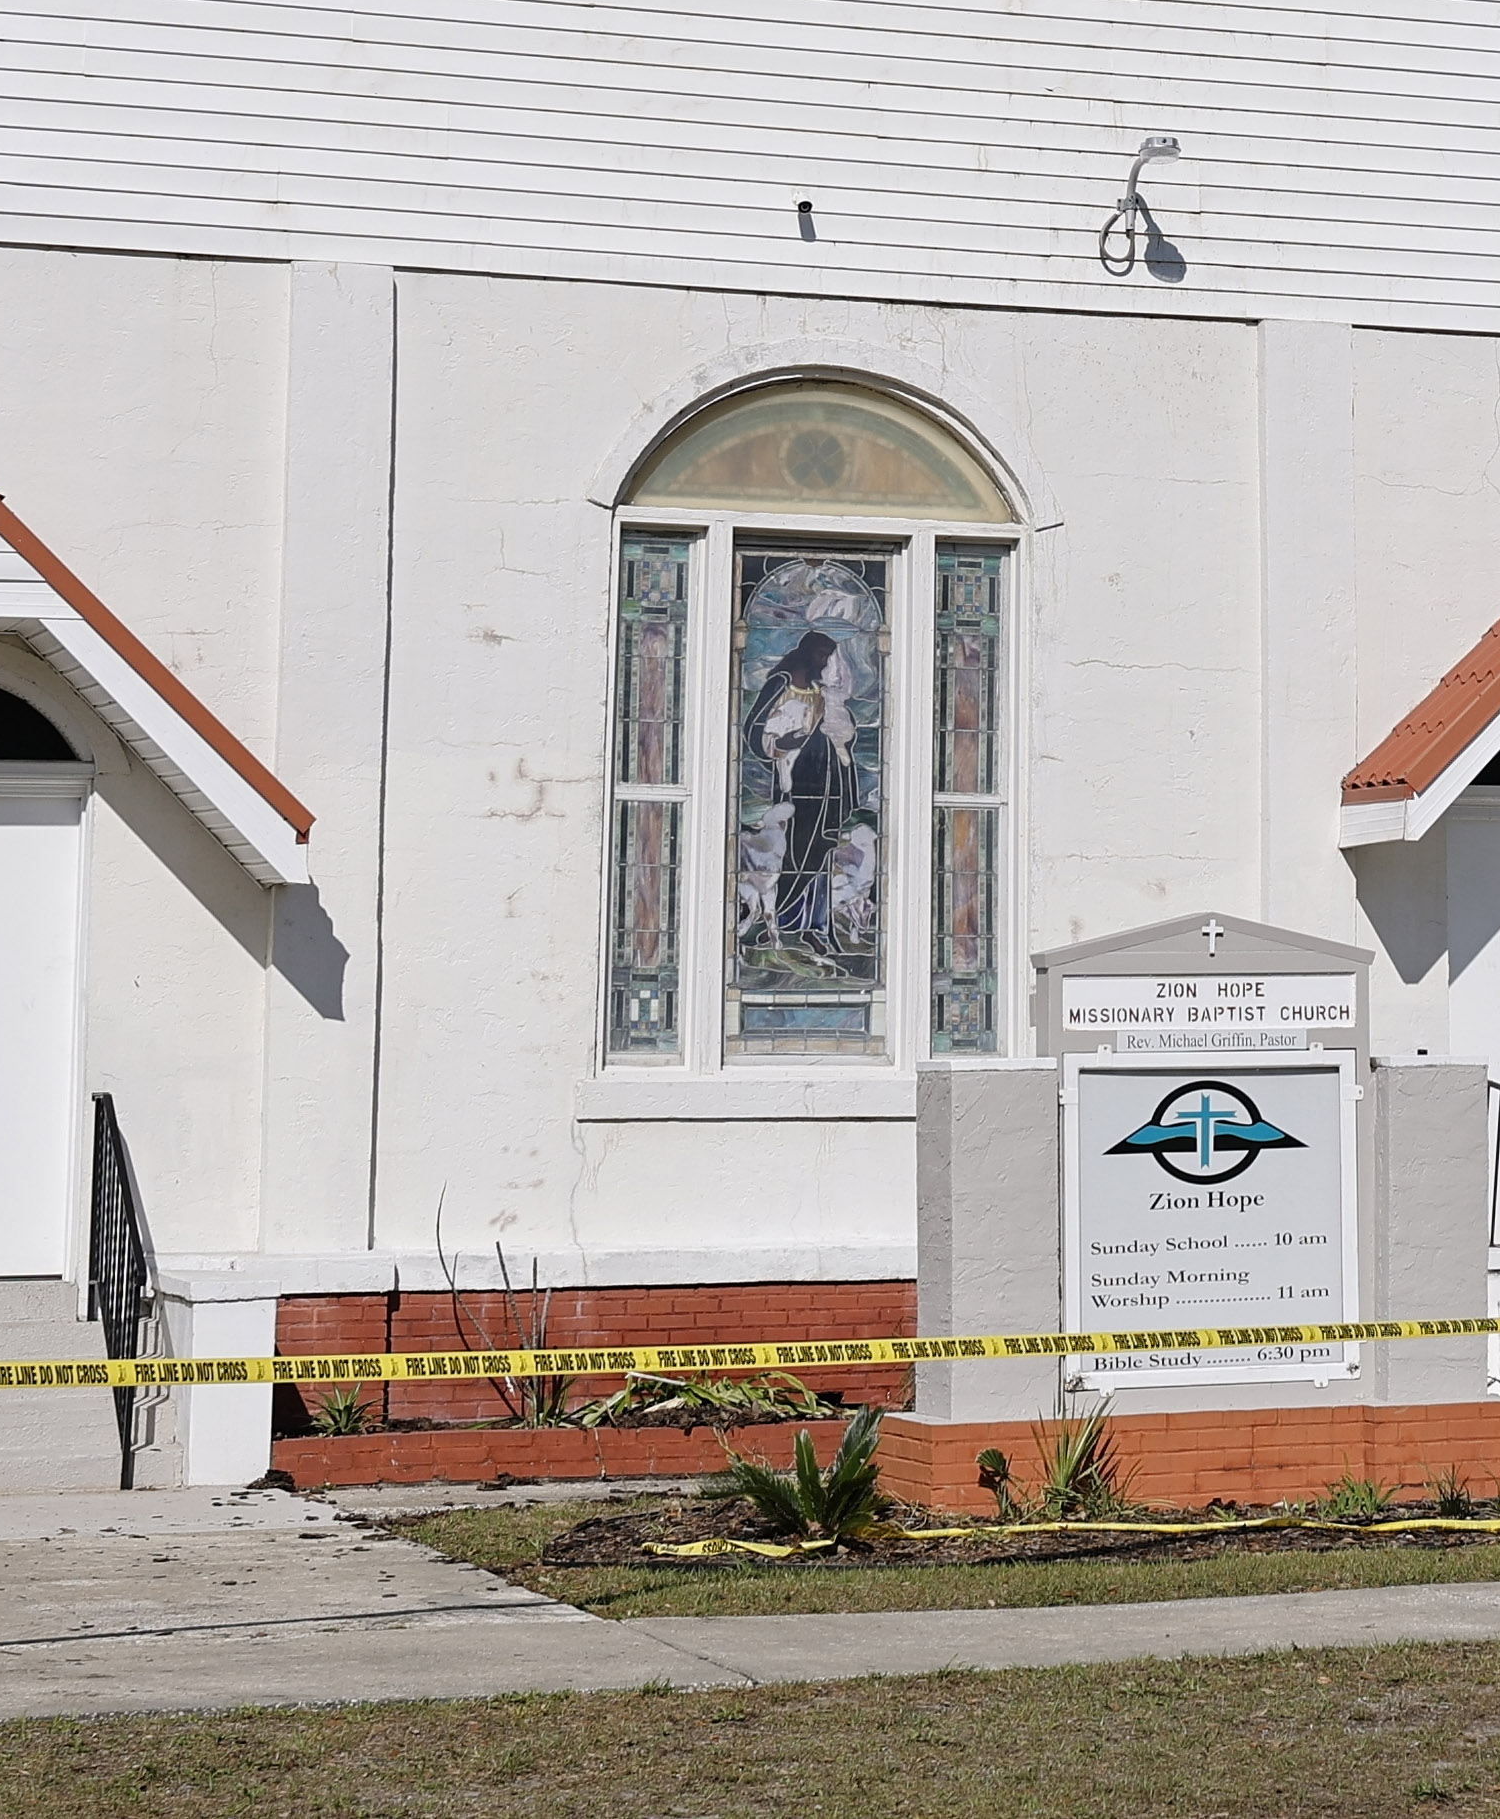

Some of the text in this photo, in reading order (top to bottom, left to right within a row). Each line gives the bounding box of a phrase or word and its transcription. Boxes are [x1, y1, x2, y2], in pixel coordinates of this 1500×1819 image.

[1156, 982, 1265, 998] ZION HOPE
[1069, 1005, 1350, 1023] MISSIONARY BAPTIST CHURCH
[1126, 1033, 1297, 1049] Rev. Michael Griffin, Pastor
[1149, 1191, 1265, 1213] Zion Hope
[1090, 1239, 1160, 1257] Sunday
[1165, 1235, 1228, 1252] School
[1273, 1233, 1293, 1246] 10
[1298, 1234, 1328, 1245] am
[1091, 1268, 1251, 1289] Sunday Morning
[1091, 1293, 1170, 1309] Worship
[1277, 1286, 1294, 1299] 11
[1301, 1287, 1330, 1298] am
[657, 1350, 676, 1367] FIRE
[678, 1350, 696, 1367] LINE
[711, 1348, 727, 1366] NOT
[728, 1347, 756, 1365] CROSS
[776, 1346, 795, 1364] FIRE
[797, 1346, 814, 1363] LINE
[828, 1344, 844, 1361] NOT
[845, 1344, 873, 1361] CROSS
[892, 1342, 910, 1359] FIRE
[911, 1342, 929, 1358] LINE
[943, 1340, 958, 1357] NOT
[959, 1339, 986, 1356] CROSS
[1094, 1356, 1143, 1371] Bible
[1149, 1352, 1203, 1367] Study
[1257, 1346, 1294, 1361] 6:30
[1299, 1347, 1331, 1363] pm
[134, 1361, 248, 1382] FIRE LINE DO NOT CROSS
[272, 1358, 382, 1379] FIRE LINE DO NOT CROSS
[405, 1355, 511, 1376] FIRE LINE DO NOT CROSS
[533, 1351, 636, 1372] FIRE LINE DO NOT CROSS
[15, 1366, 37, 1385] LINE
[39, 1365, 53, 1384] DO
[55, 1365, 74, 1384] NOT
[75, 1364, 109, 1384] CROSS
